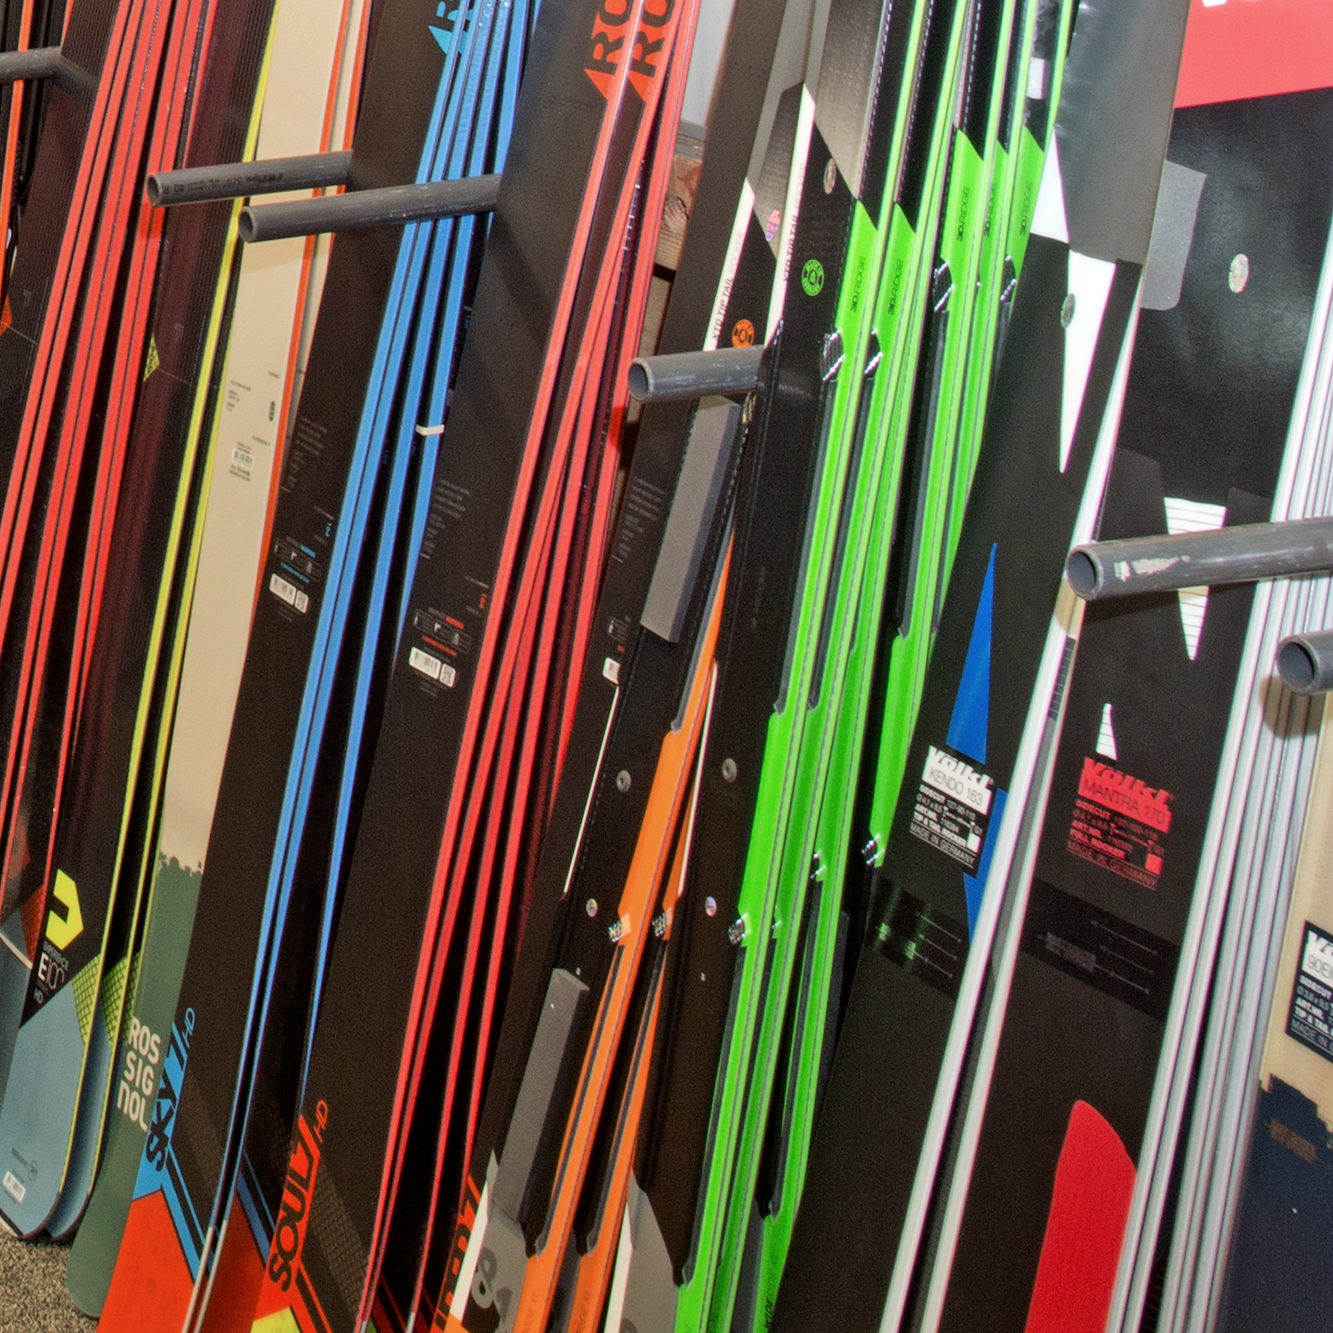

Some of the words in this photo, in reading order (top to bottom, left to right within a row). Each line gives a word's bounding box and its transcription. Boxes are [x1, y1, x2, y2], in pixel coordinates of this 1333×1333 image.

[928, 744, 991, 789] Völkl
[928, 767, 965, 796] KENDO
[966, 785, 983, 806] 163
[1084, 756, 1170, 805] Völkl
[919, 784, 946, 804] SIDECUT
[1084, 778, 1140, 812] MANTRA
[1144, 804, 1166, 824] 170
[910, 822, 931, 840] MADE
[940, 839, 976, 864] GERMANY
[928, 819, 942, 834] TAIL
[941, 827, 967, 848] ROCKER
[1299, 974, 1332, 1000] SIDECUT
[128, 1015, 161, 1065] ROS
[181, 1007, 196, 1048] HD
[1291, 1018, 1317, 1040] MADE
[1318, 1032, 1329, 1047] IN
[1293, 1005, 1307, 1020] TIP
[1314, 1016, 1330, 1034] TAIL
[124, 1050, 154, 1097] SIG
[313, 1099, 328, 1143] HD
